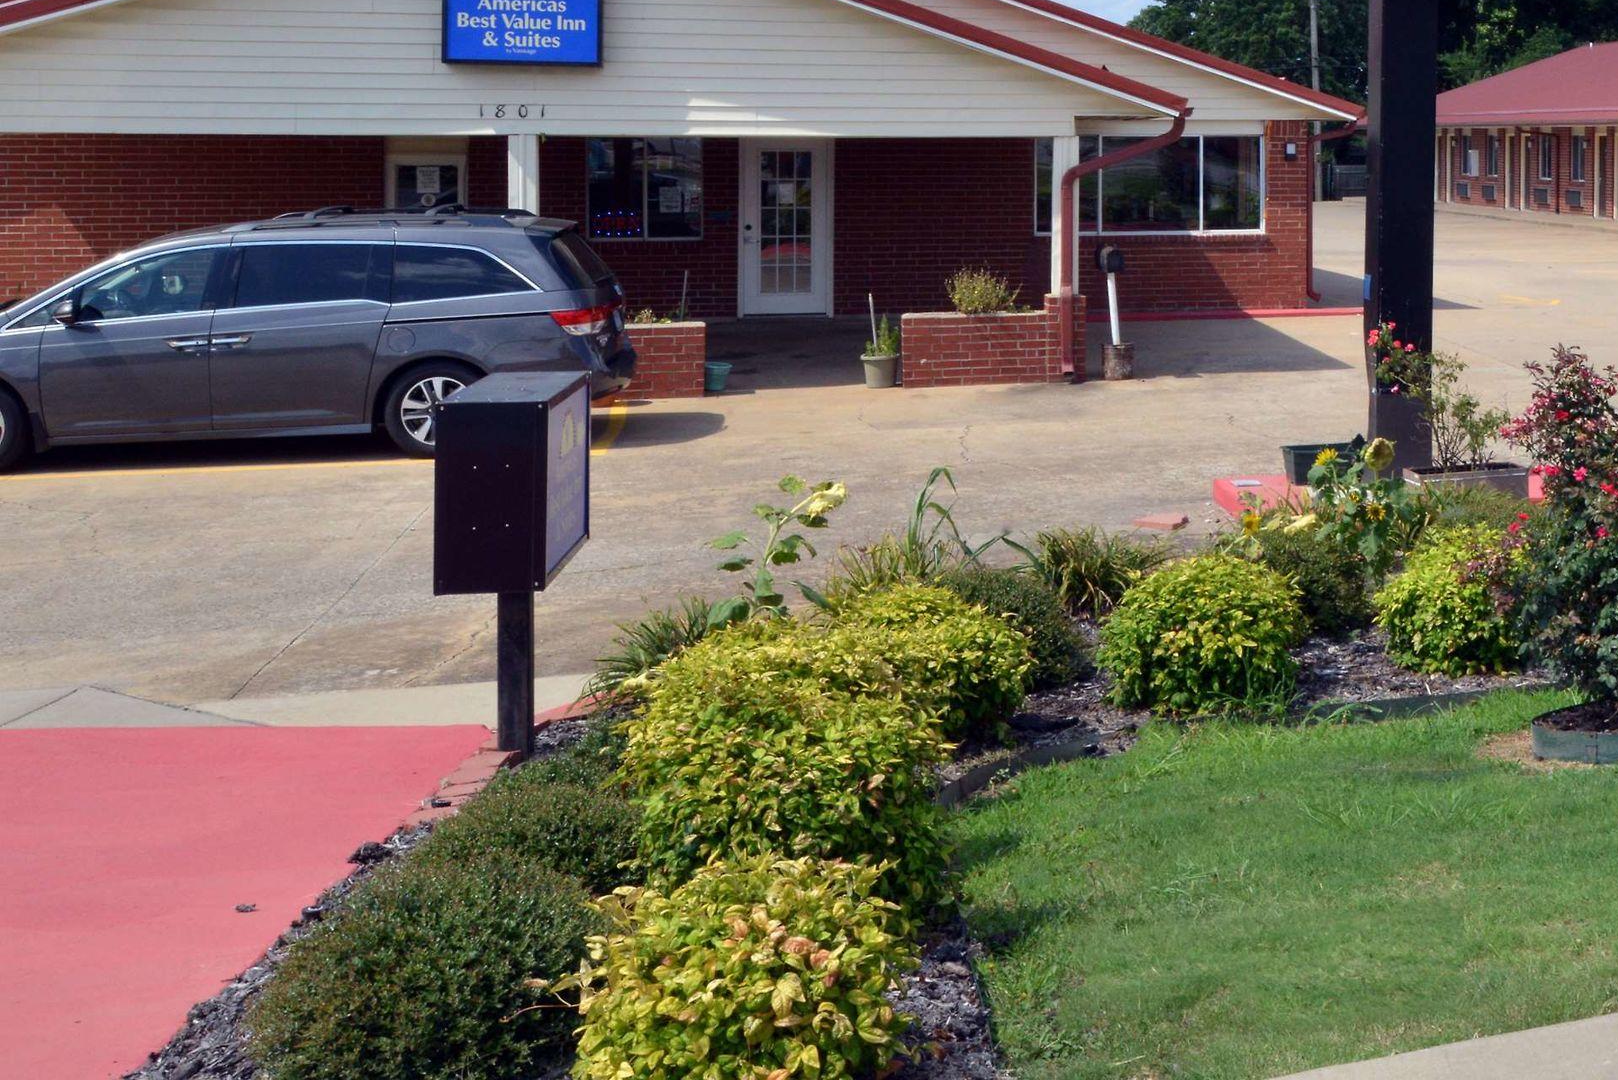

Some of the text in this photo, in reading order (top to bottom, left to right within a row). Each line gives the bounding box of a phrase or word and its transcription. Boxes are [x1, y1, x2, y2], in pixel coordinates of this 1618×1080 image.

[456, 11, 587, 31] Best Value Inn
[482, 31, 561, 49] & Suites
[479, 104, 545, 119] 1801
